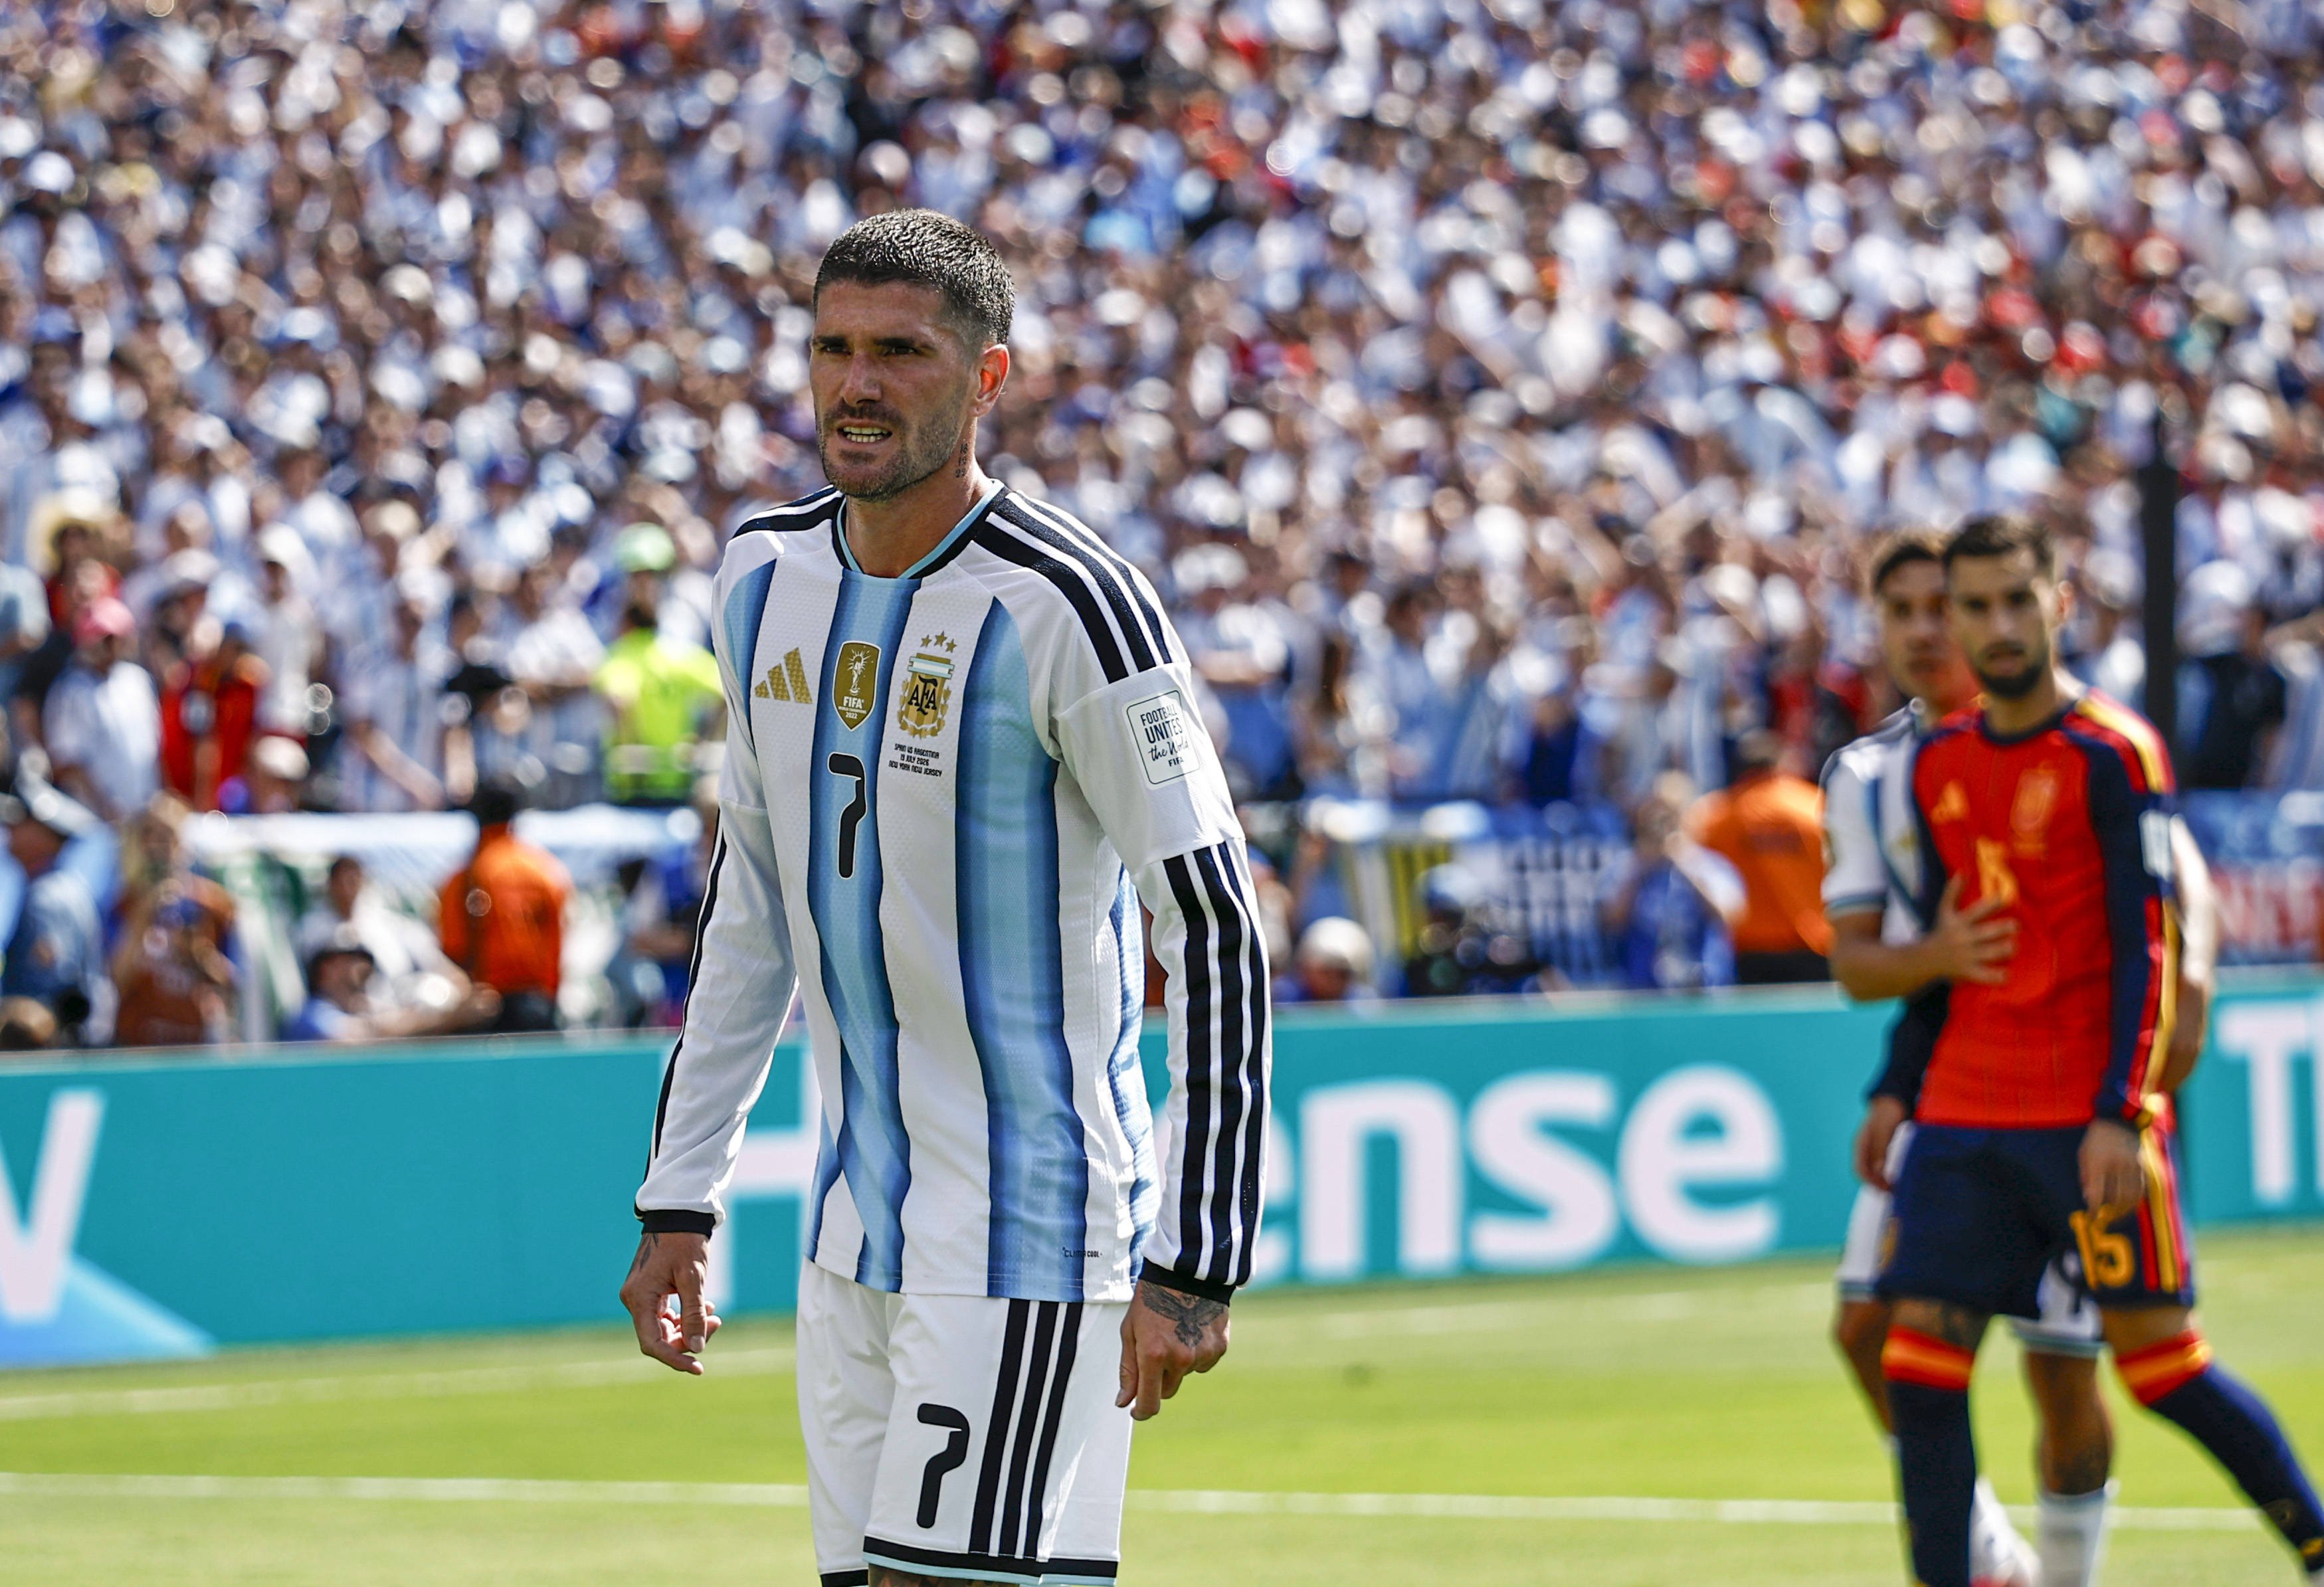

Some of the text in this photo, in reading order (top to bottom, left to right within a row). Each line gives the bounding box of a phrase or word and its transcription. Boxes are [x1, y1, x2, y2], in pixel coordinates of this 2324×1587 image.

[843, 696, 863, 709] FIFA
[1140, 703, 1177, 726] FOOTBALL
[1145, 717, 1183, 744] UNITES
[894, 743, 906, 752] SPAIN
[914, 747, 939, 759] ARGENTINA
[1148, 745, 1167, 761] the
[888, 760, 942, 777] NEW YORK NEW JERSEY
[917, 757, 929, 766] 2026
[1168, 757, 1184, 767] FIFA
[828, 753, 865, 878] 7
[917, 1403, 970, 1529] 7
